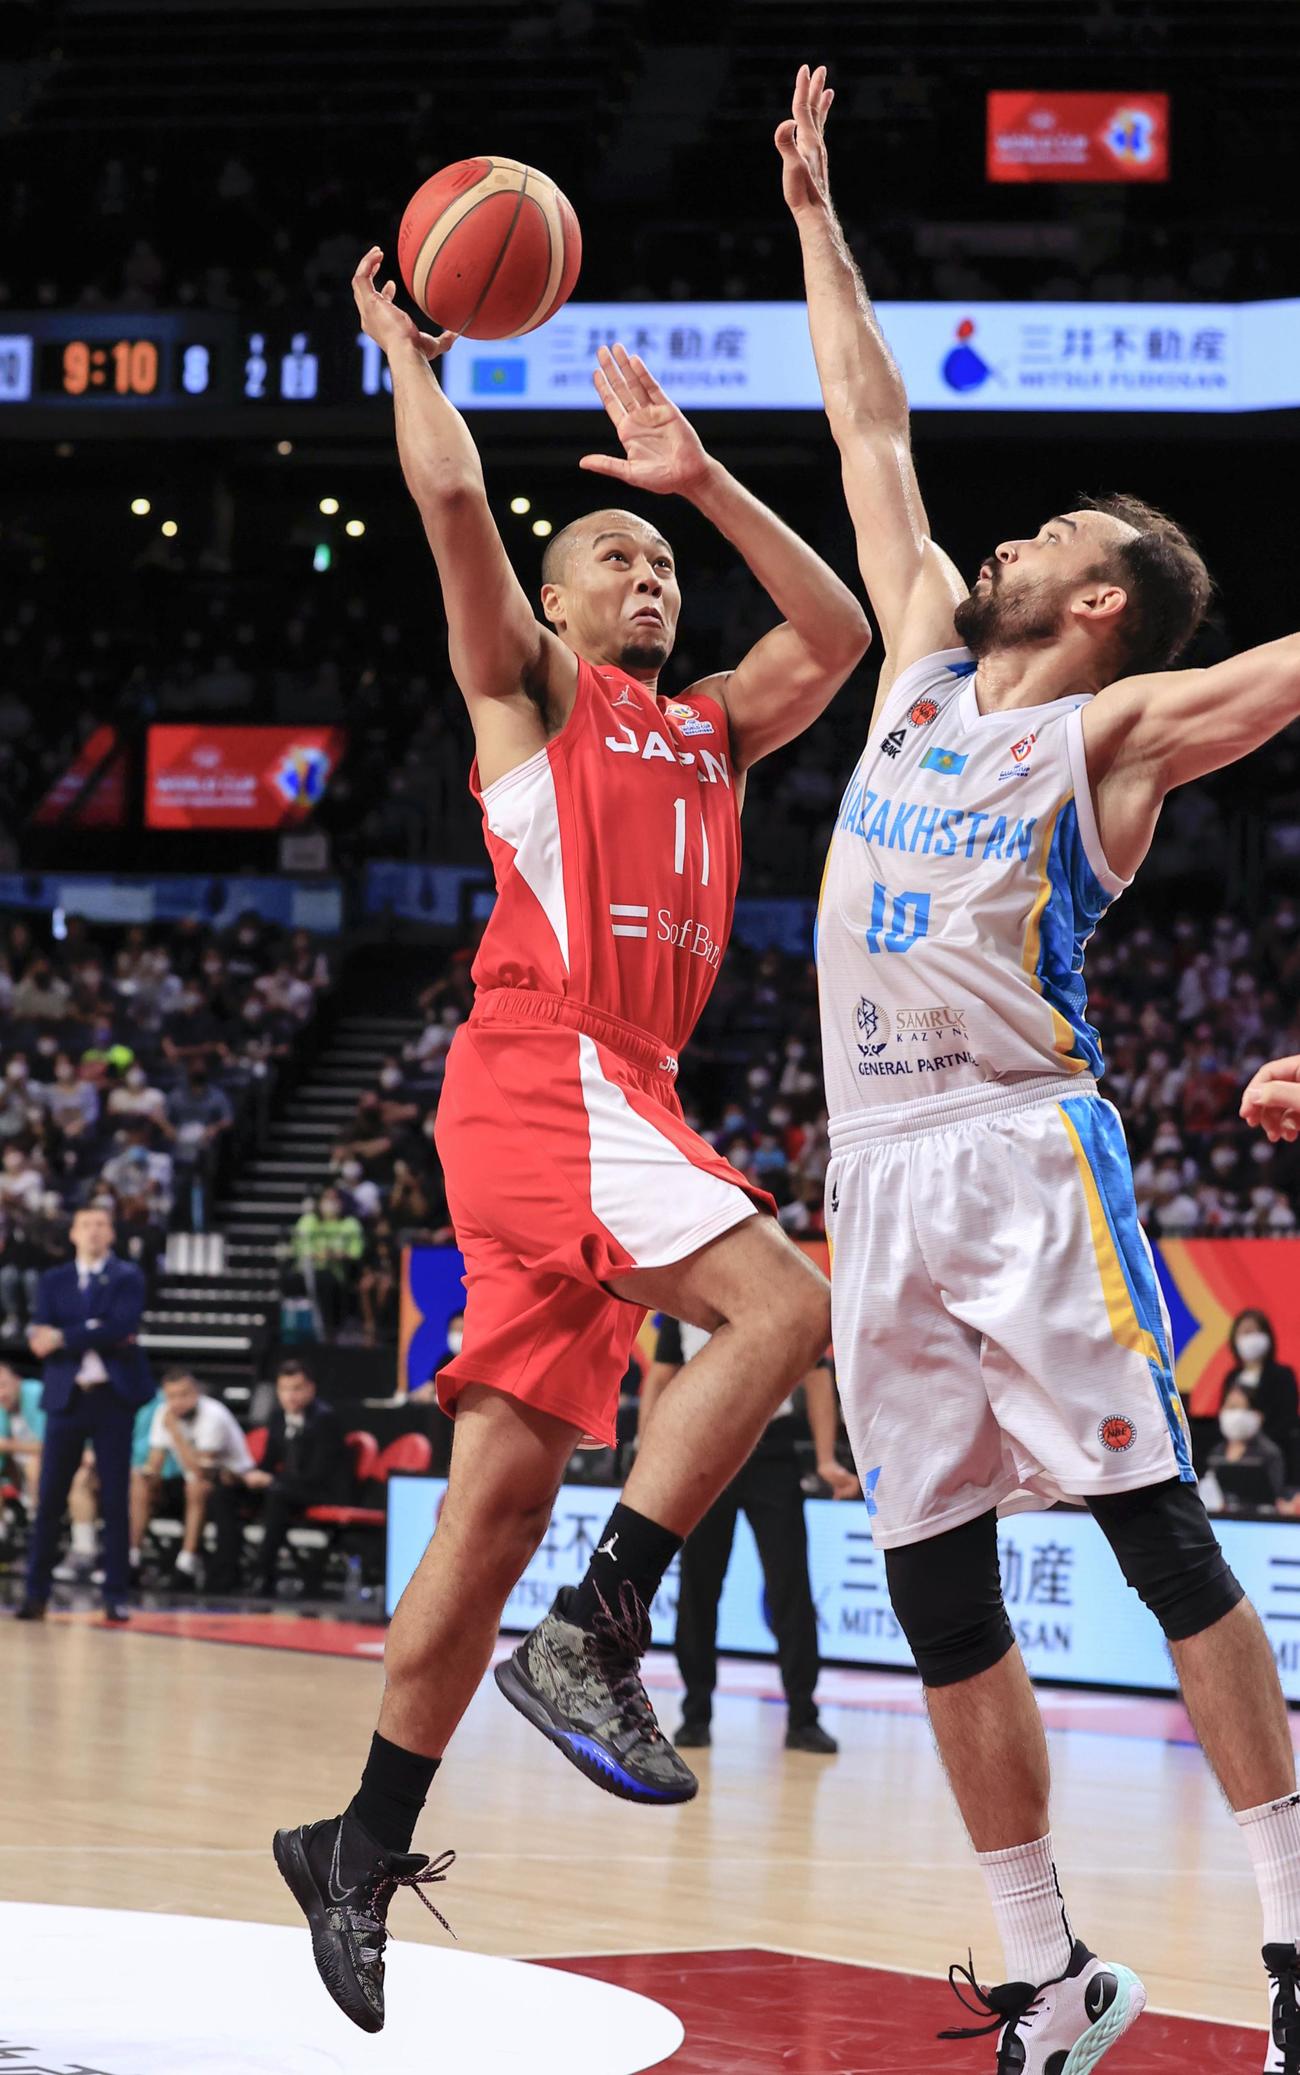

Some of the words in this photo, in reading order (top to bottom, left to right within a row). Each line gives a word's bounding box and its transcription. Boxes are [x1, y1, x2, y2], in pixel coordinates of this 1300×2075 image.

[63, 341, 158, 395] 9:10
[880, 738, 901, 760] EAK
[866, 880, 931, 954] 10
[858, 1060, 913, 1076] GENERAL
